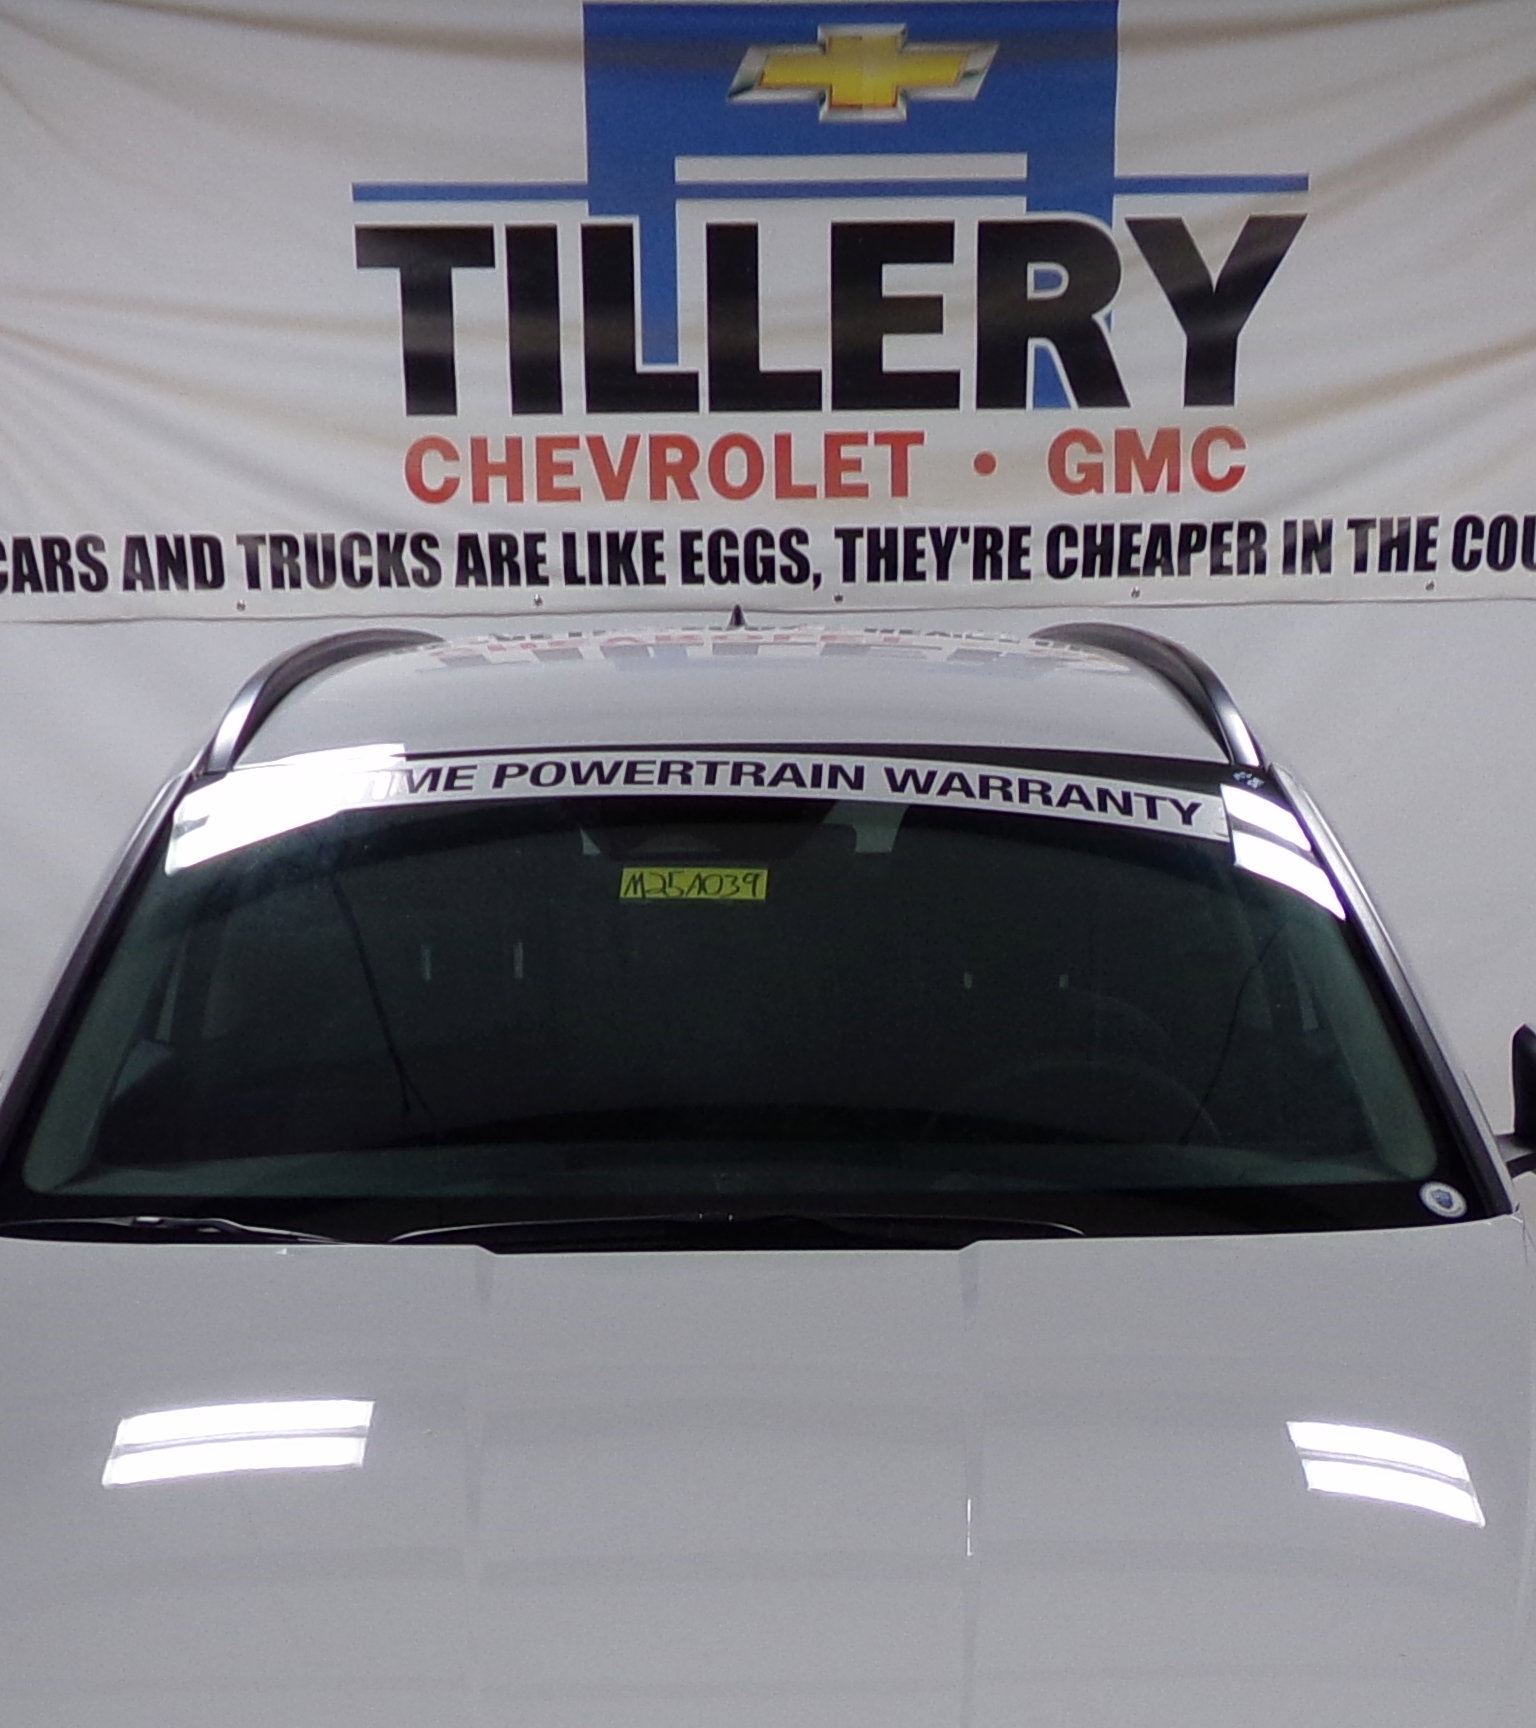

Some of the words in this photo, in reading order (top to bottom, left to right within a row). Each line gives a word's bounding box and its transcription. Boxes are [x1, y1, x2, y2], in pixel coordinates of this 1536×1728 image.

[355, 213, 1307, 415] TILLERY
[404, 431, 924, 503] CHEVROLET
[1047, 426, 1247, 496] GMC
[122, 533, 226, 592] AND
[236, 531, 442, 590] TRUCKS
[454, 531, 550, 587] ARE
[563, 529, 666, 586] LIKE
[679, 527, 822, 590] EGGS,
[834, 525, 1031, 583] THEY'RE
[1045, 520, 1267, 579] CHEAPER
[1281, 518, 1333, 575] IN
[1347, 515, 1440, 574] THE
[491, 760, 865, 791] POWERTRAIN
[883, 767, 1202, 827] WARRANTY
